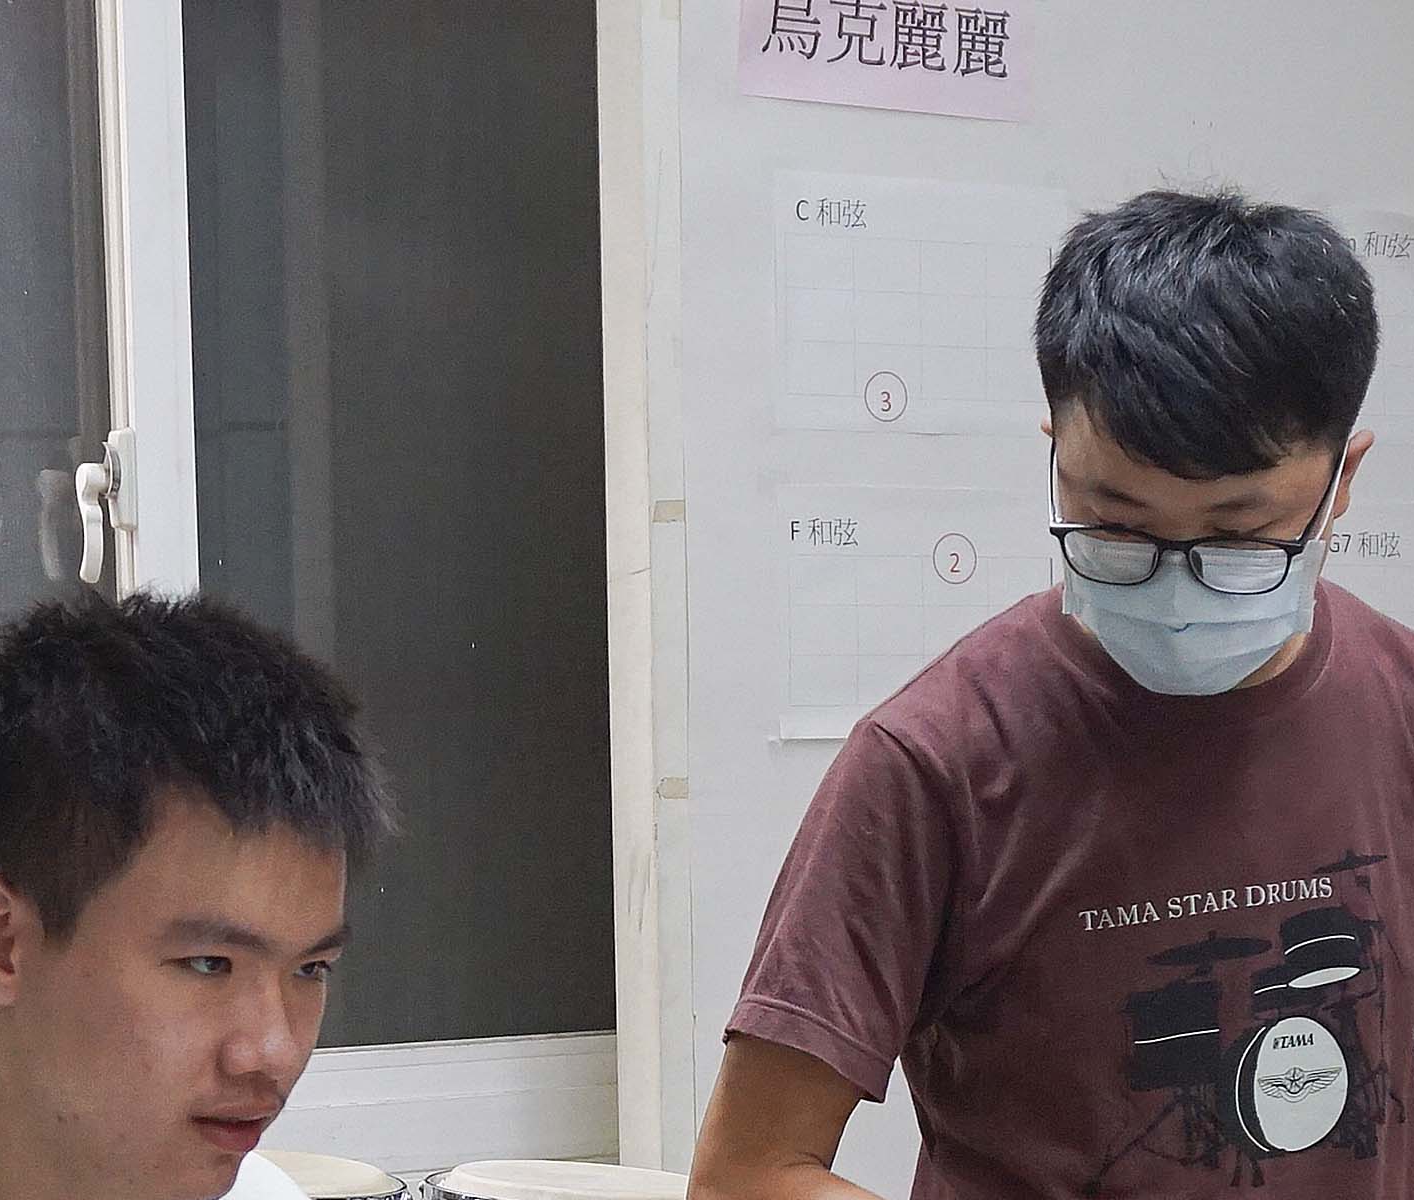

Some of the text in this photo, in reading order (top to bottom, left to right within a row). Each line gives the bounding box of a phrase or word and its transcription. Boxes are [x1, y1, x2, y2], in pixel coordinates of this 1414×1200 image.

[796, 197, 867, 229] C 和弦
[1363, 231, 1414, 258] 和弦
[791, 517, 859, 547] F 和弦
[1329, 530, 1401, 558] G7 和弦
[1079, 876, 1333, 931] TAMA STAR DRUMS
[1277, 1033, 1314, 1049] TAMA
